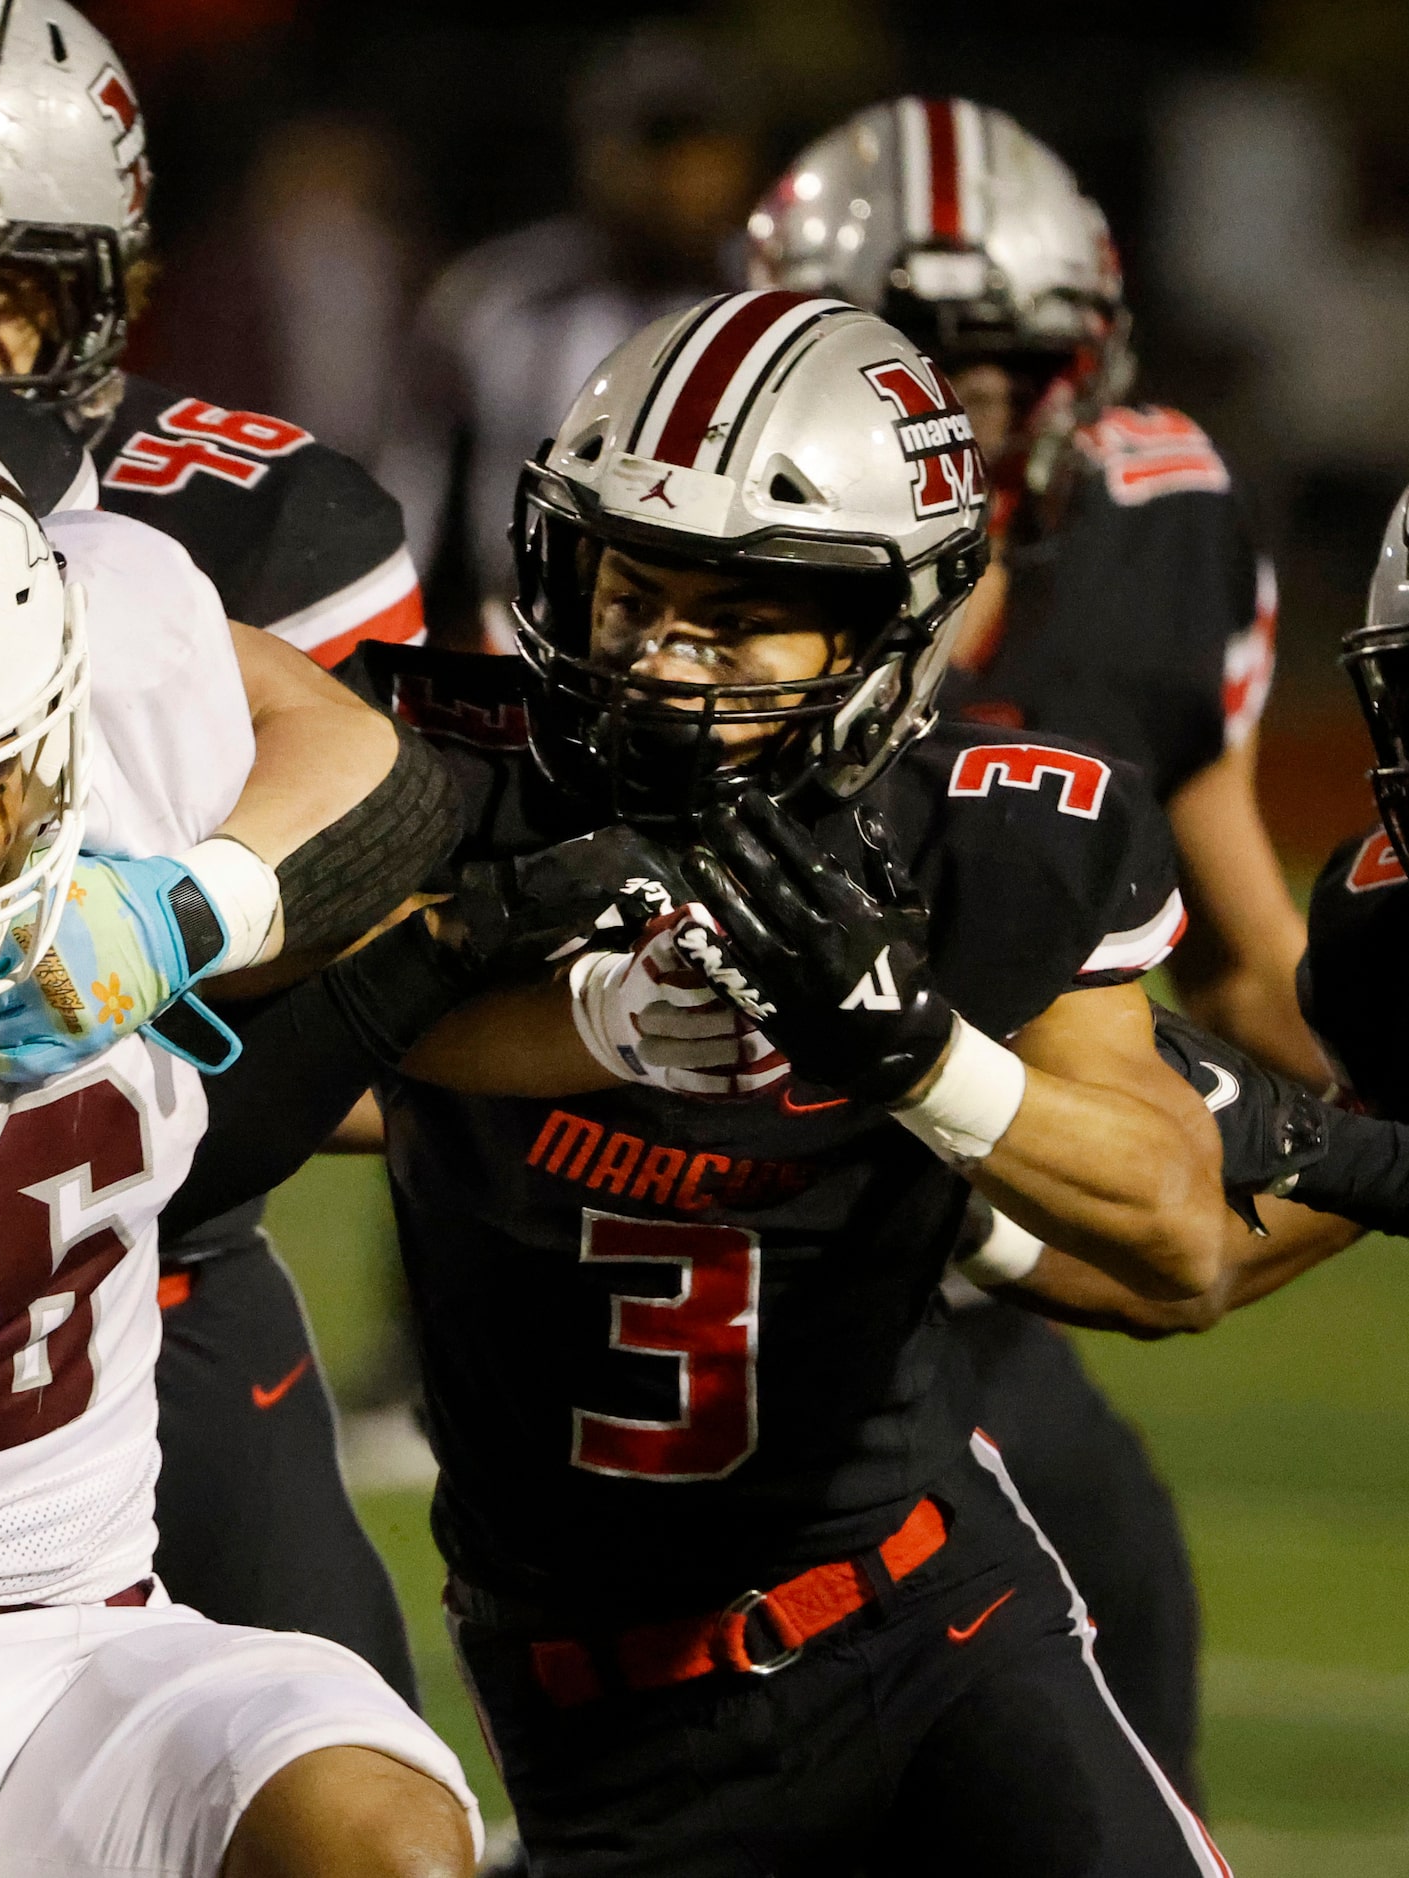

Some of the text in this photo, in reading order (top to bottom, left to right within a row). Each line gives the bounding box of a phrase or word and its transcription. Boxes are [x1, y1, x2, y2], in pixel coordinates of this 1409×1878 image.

[101, 397, 316, 496] 46
[948, 744, 1112, 820] 3
[570, 1206, 762, 1483] 3
